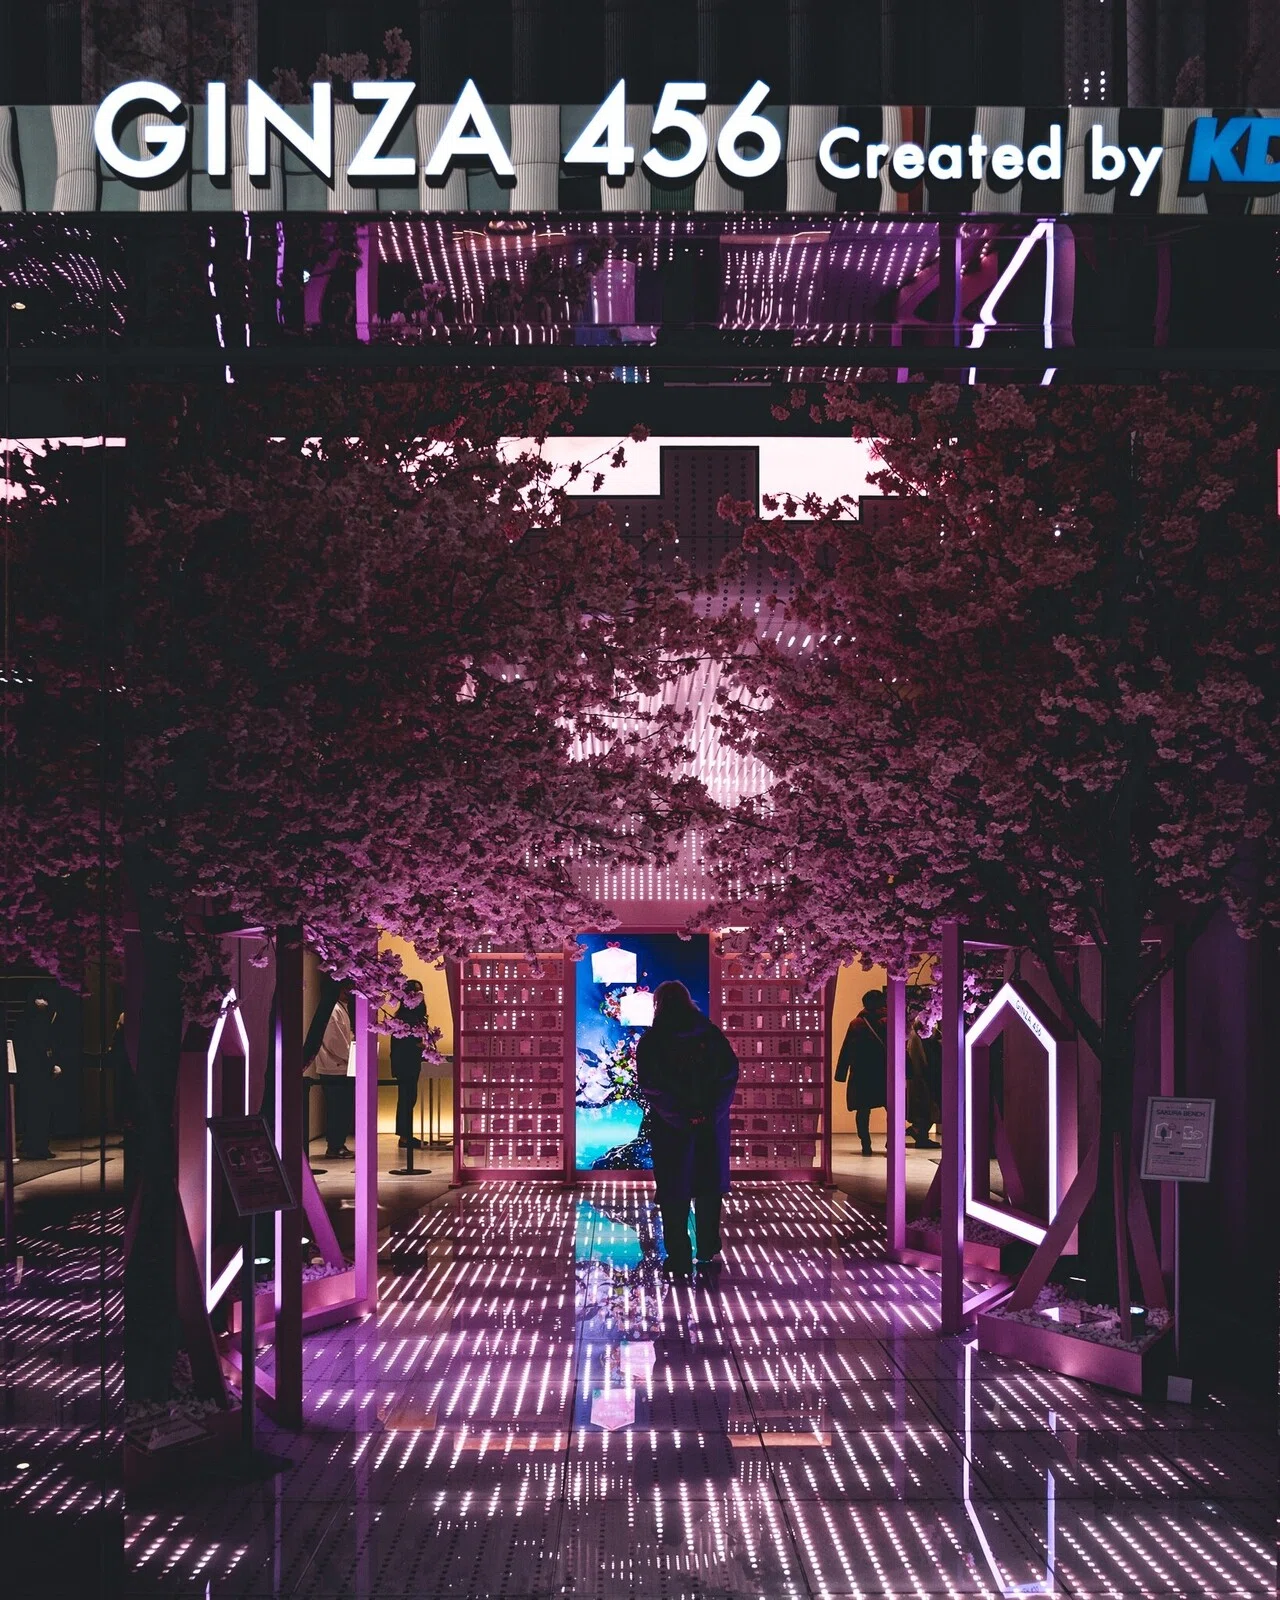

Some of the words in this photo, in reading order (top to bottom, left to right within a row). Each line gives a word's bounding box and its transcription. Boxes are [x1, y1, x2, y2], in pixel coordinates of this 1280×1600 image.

[93, 78, 516, 180] GINZA
[563, 79, 781, 179] 456
[819, 124, 1062, 180] Created
[1091, 124, 1164, 197] by
[1015, 999, 1032, 1025] GINZA
